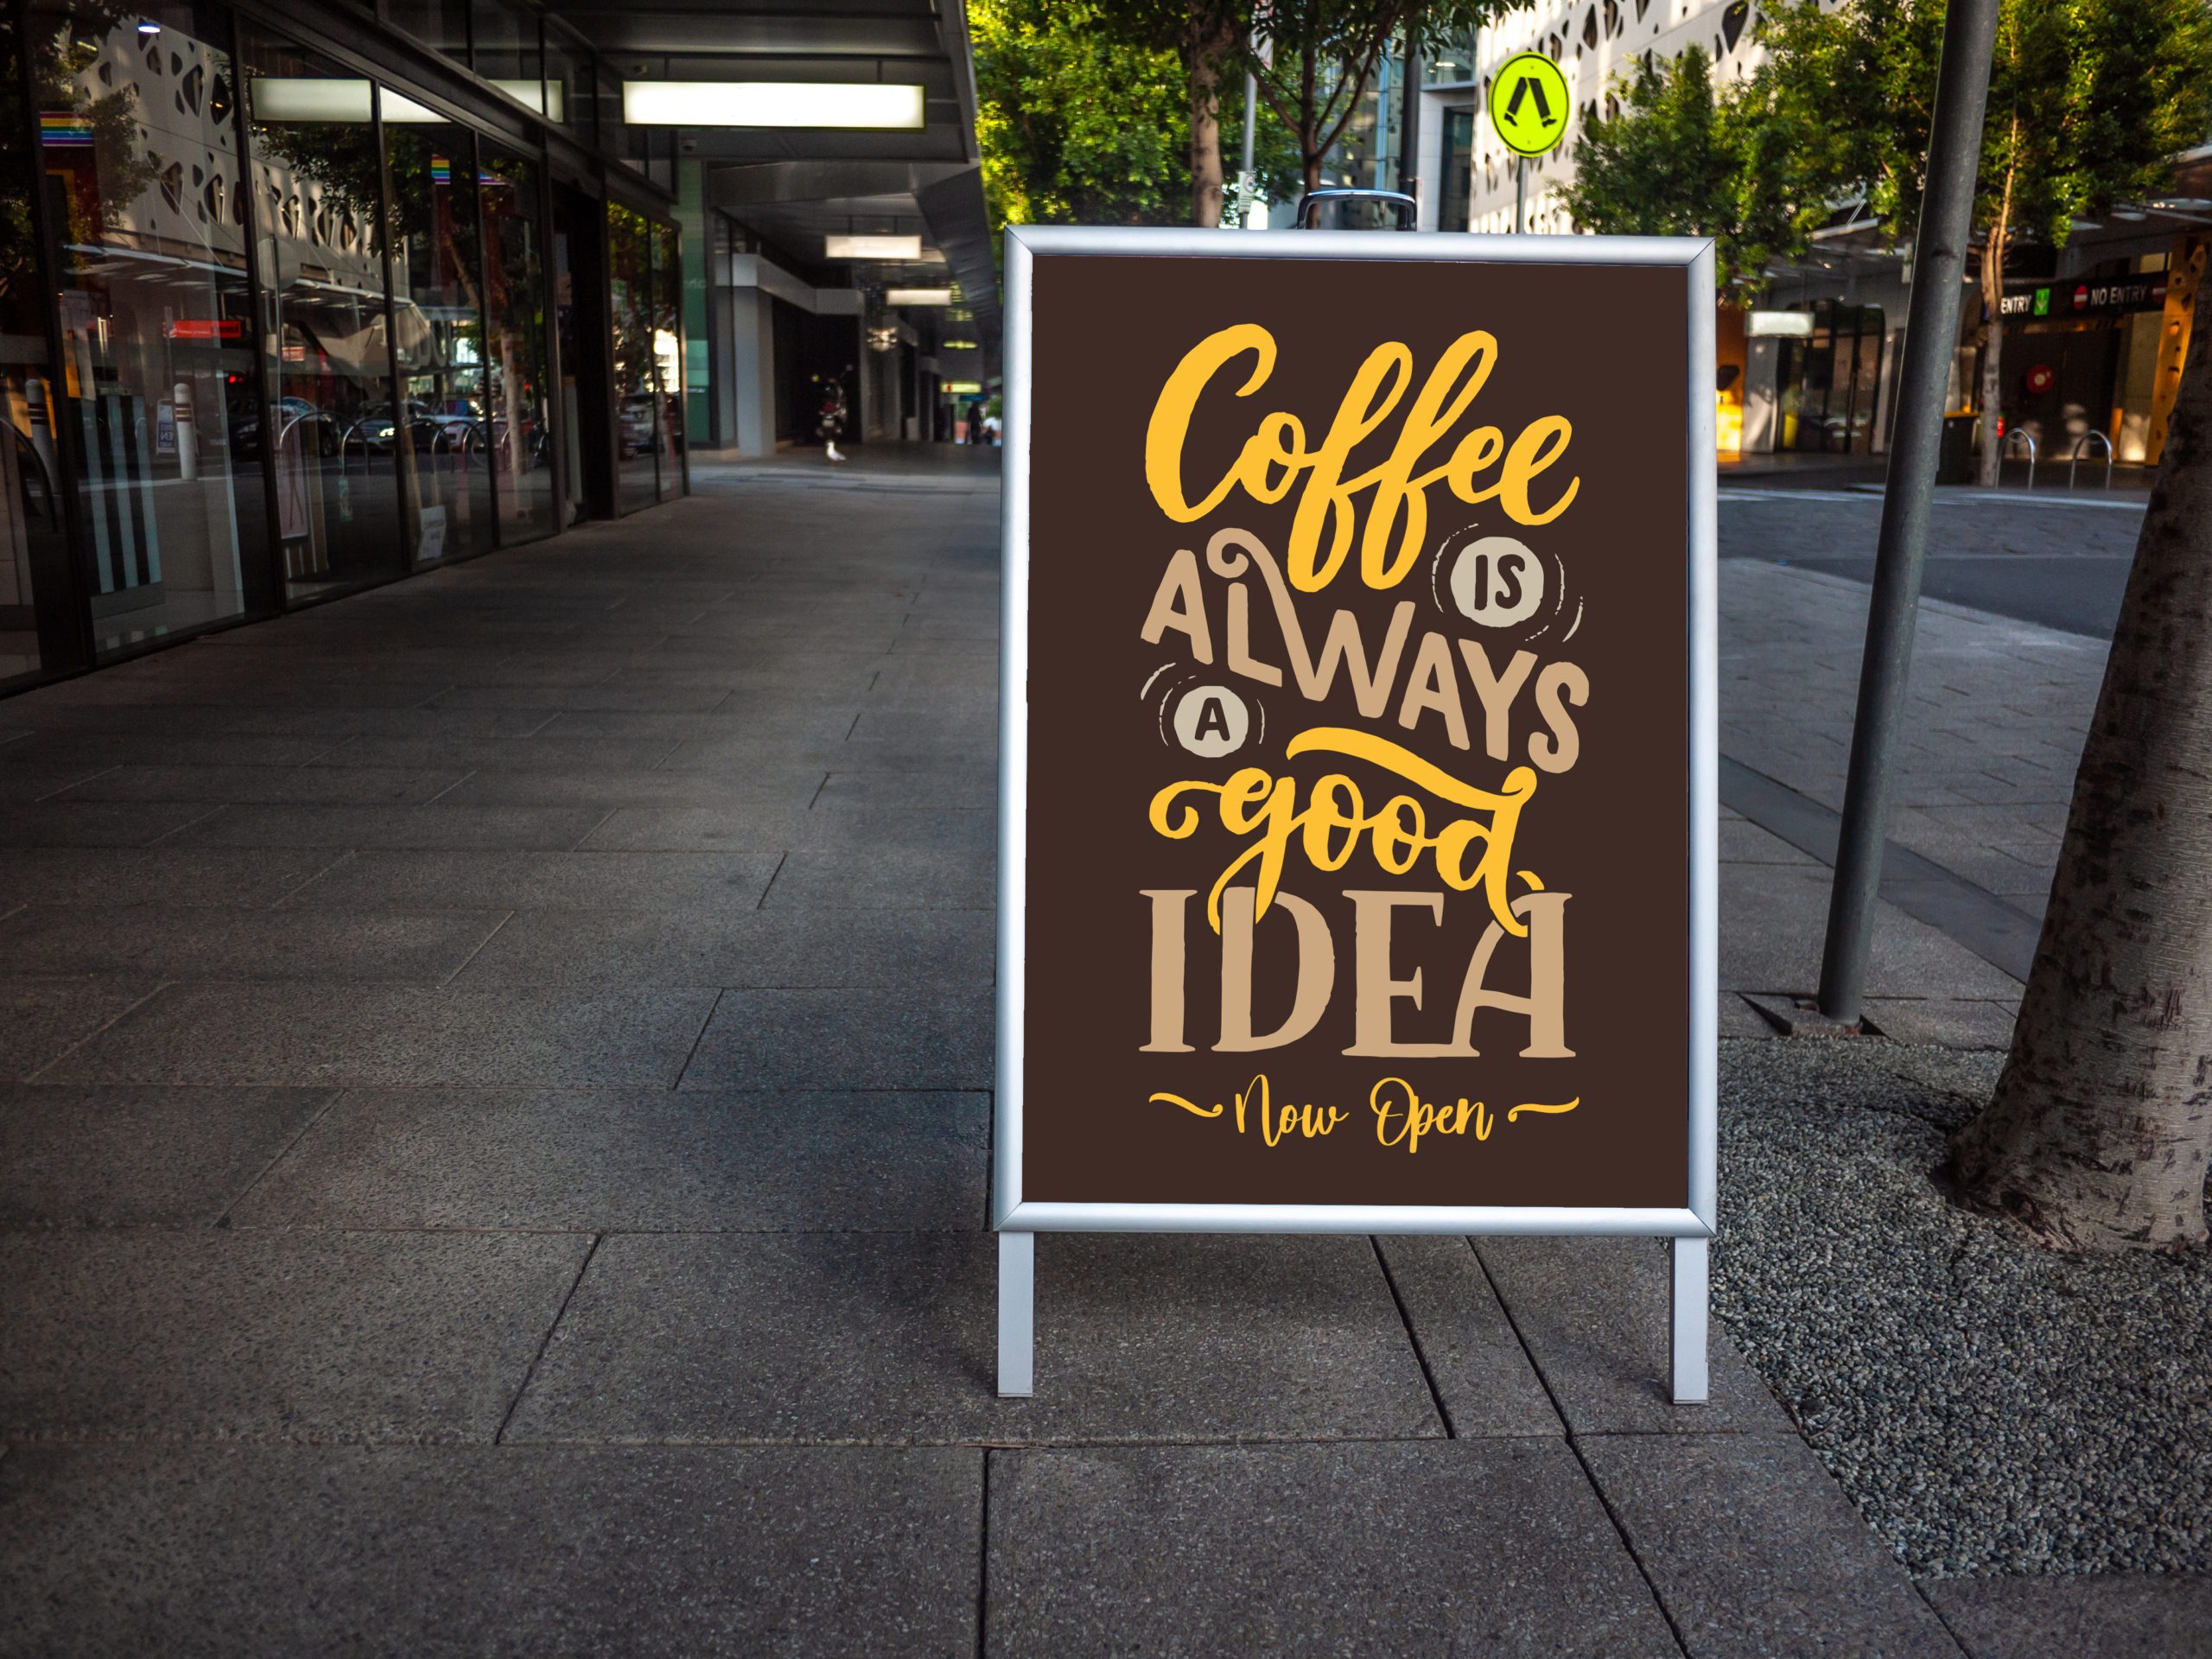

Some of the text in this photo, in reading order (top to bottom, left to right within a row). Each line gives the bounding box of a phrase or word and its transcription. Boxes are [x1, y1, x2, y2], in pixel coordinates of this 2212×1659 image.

[2000, 295, 2032, 315] ENTRY
[2091, 285, 2147, 306] NO ENTRY
[1145, 323, 1580, 593] Coffee
[1474, 554, 1525, 611] IS
[1141, 527, 1590, 774] ALWAYS
[1194, 697, 1230, 742] A
[1149, 727, 1545, 938] good
[1139, 887, 1577, 1059] IDEA
[1235, 1074, 1494, 1154] Now Open
